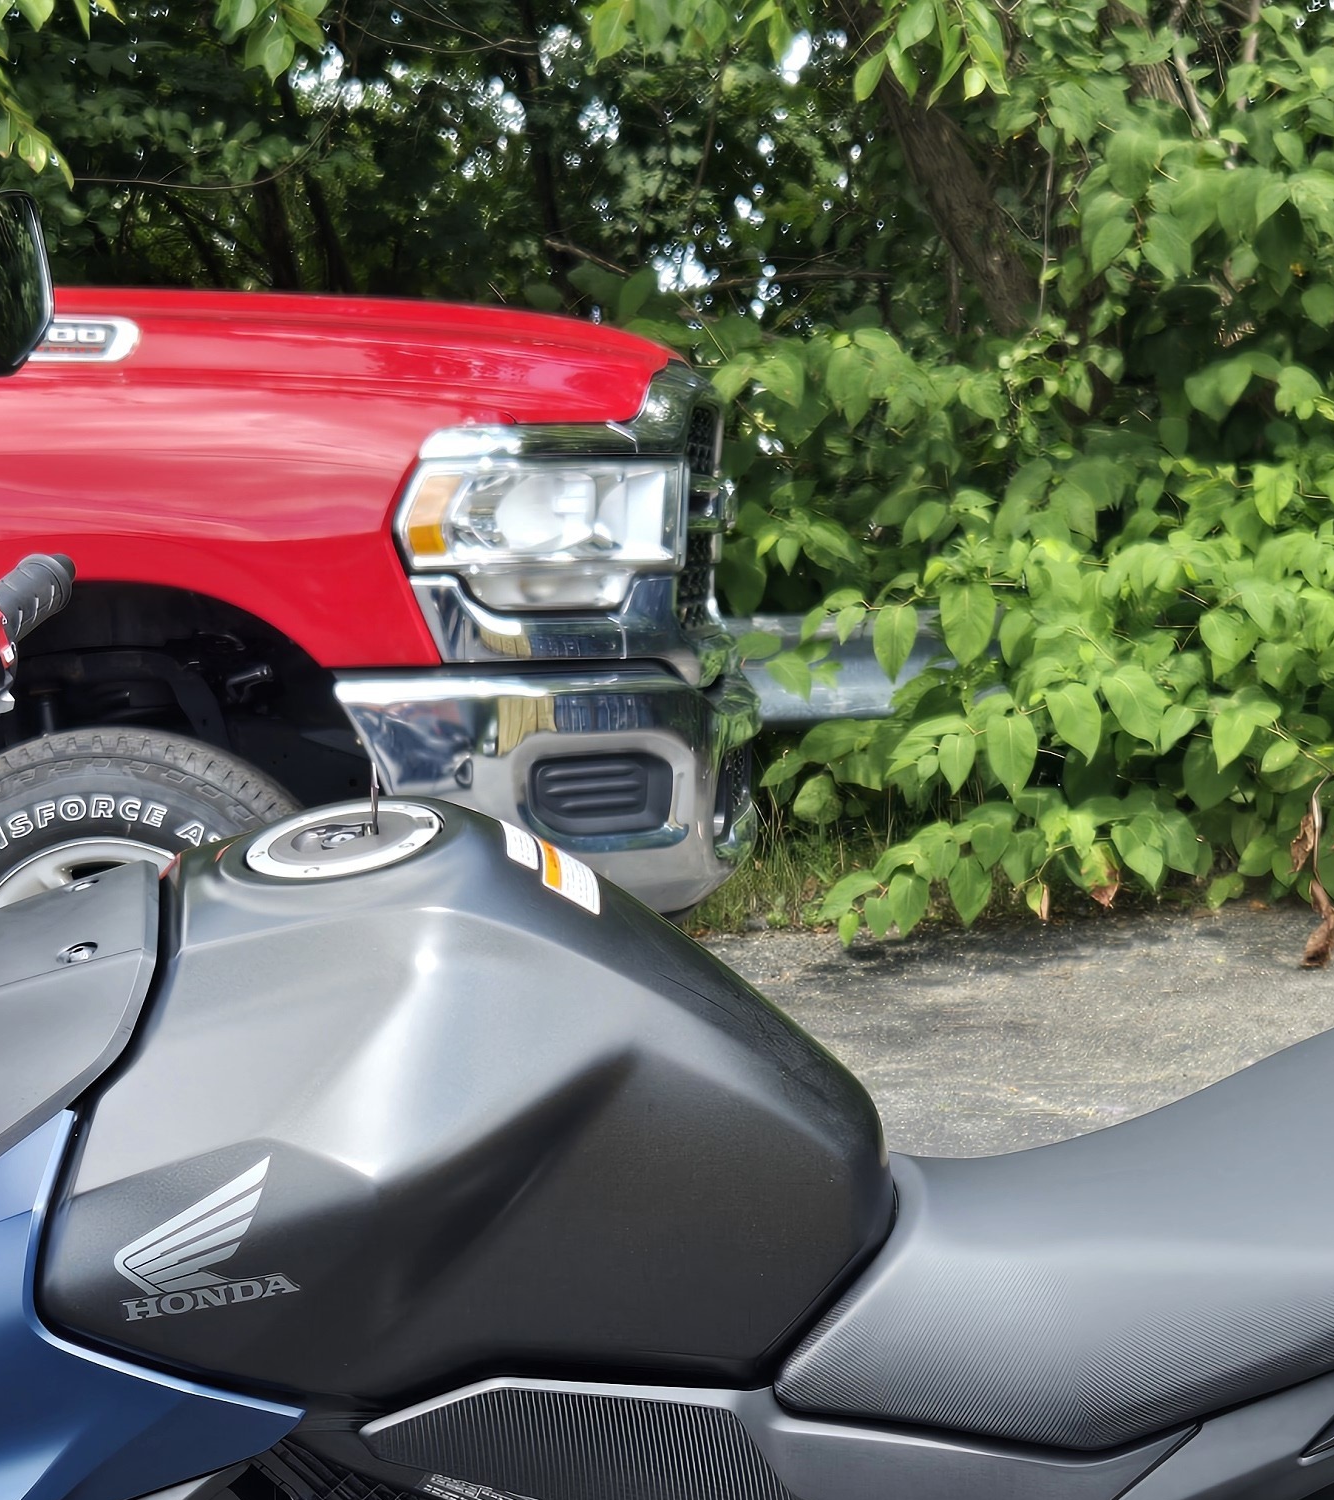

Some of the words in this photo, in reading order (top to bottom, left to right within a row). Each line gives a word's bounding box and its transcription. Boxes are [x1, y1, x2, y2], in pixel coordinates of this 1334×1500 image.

[48, 327, 106, 342] 00
[176, 820, 221, 847] A
[122, 1273, 301, 1322] HONDA
